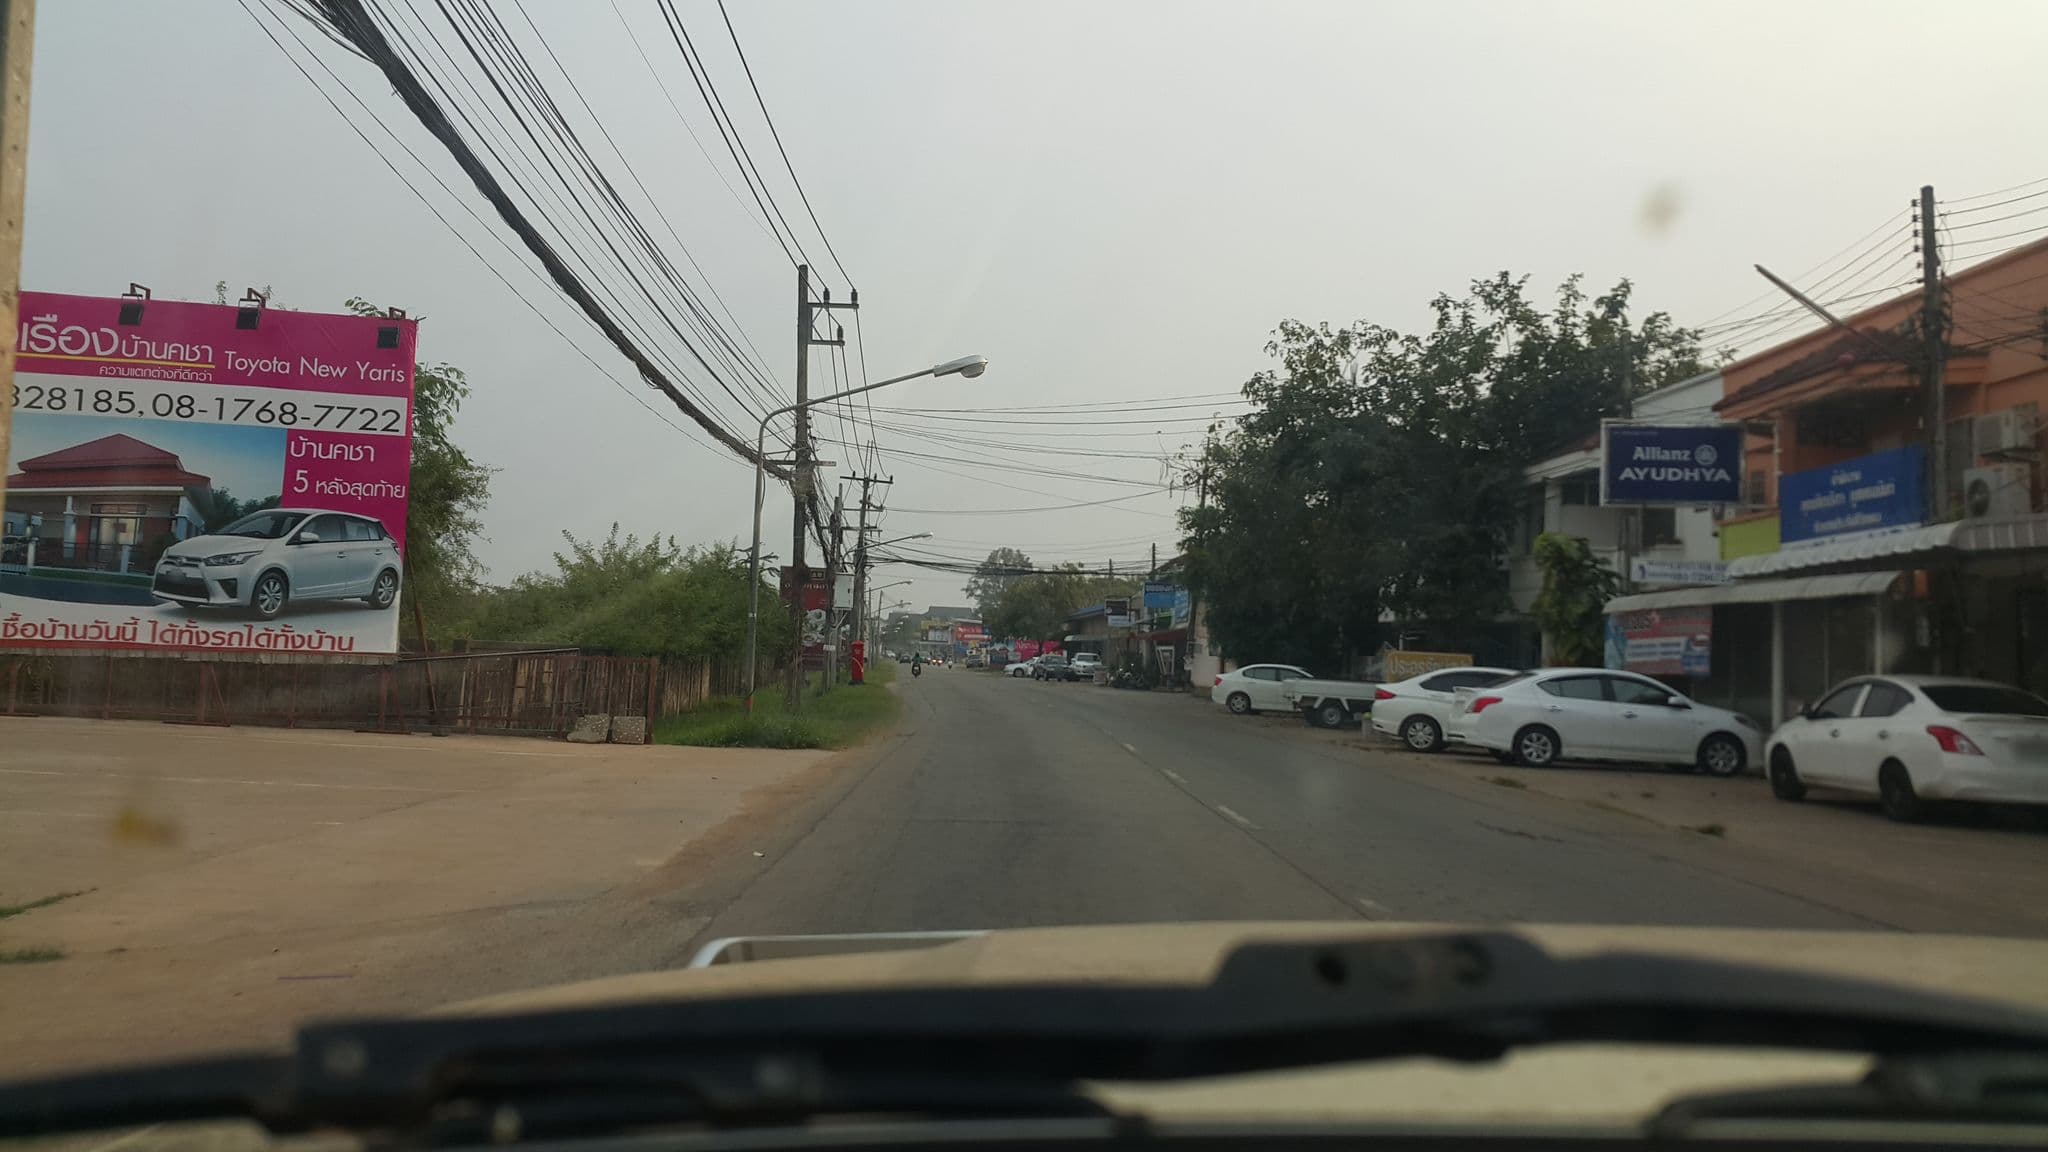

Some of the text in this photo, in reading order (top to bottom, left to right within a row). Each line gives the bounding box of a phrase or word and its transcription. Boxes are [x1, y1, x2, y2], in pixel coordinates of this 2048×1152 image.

[14, 313, 214, 363] เรือง บ้านคชา
[99, 364, 213, 382] ความแตกต่างที่ดีกว่า
[224, 350, 405, 383] Toyota New Yaris
[290, 435, 375, 462] บ้านคชา
[1632, 446, 1692, 461] Allianz
[293, 469, 406, 500] 5 หลังสุดท้าย
[1618, 467, 1731, 482] AYUDHYA
